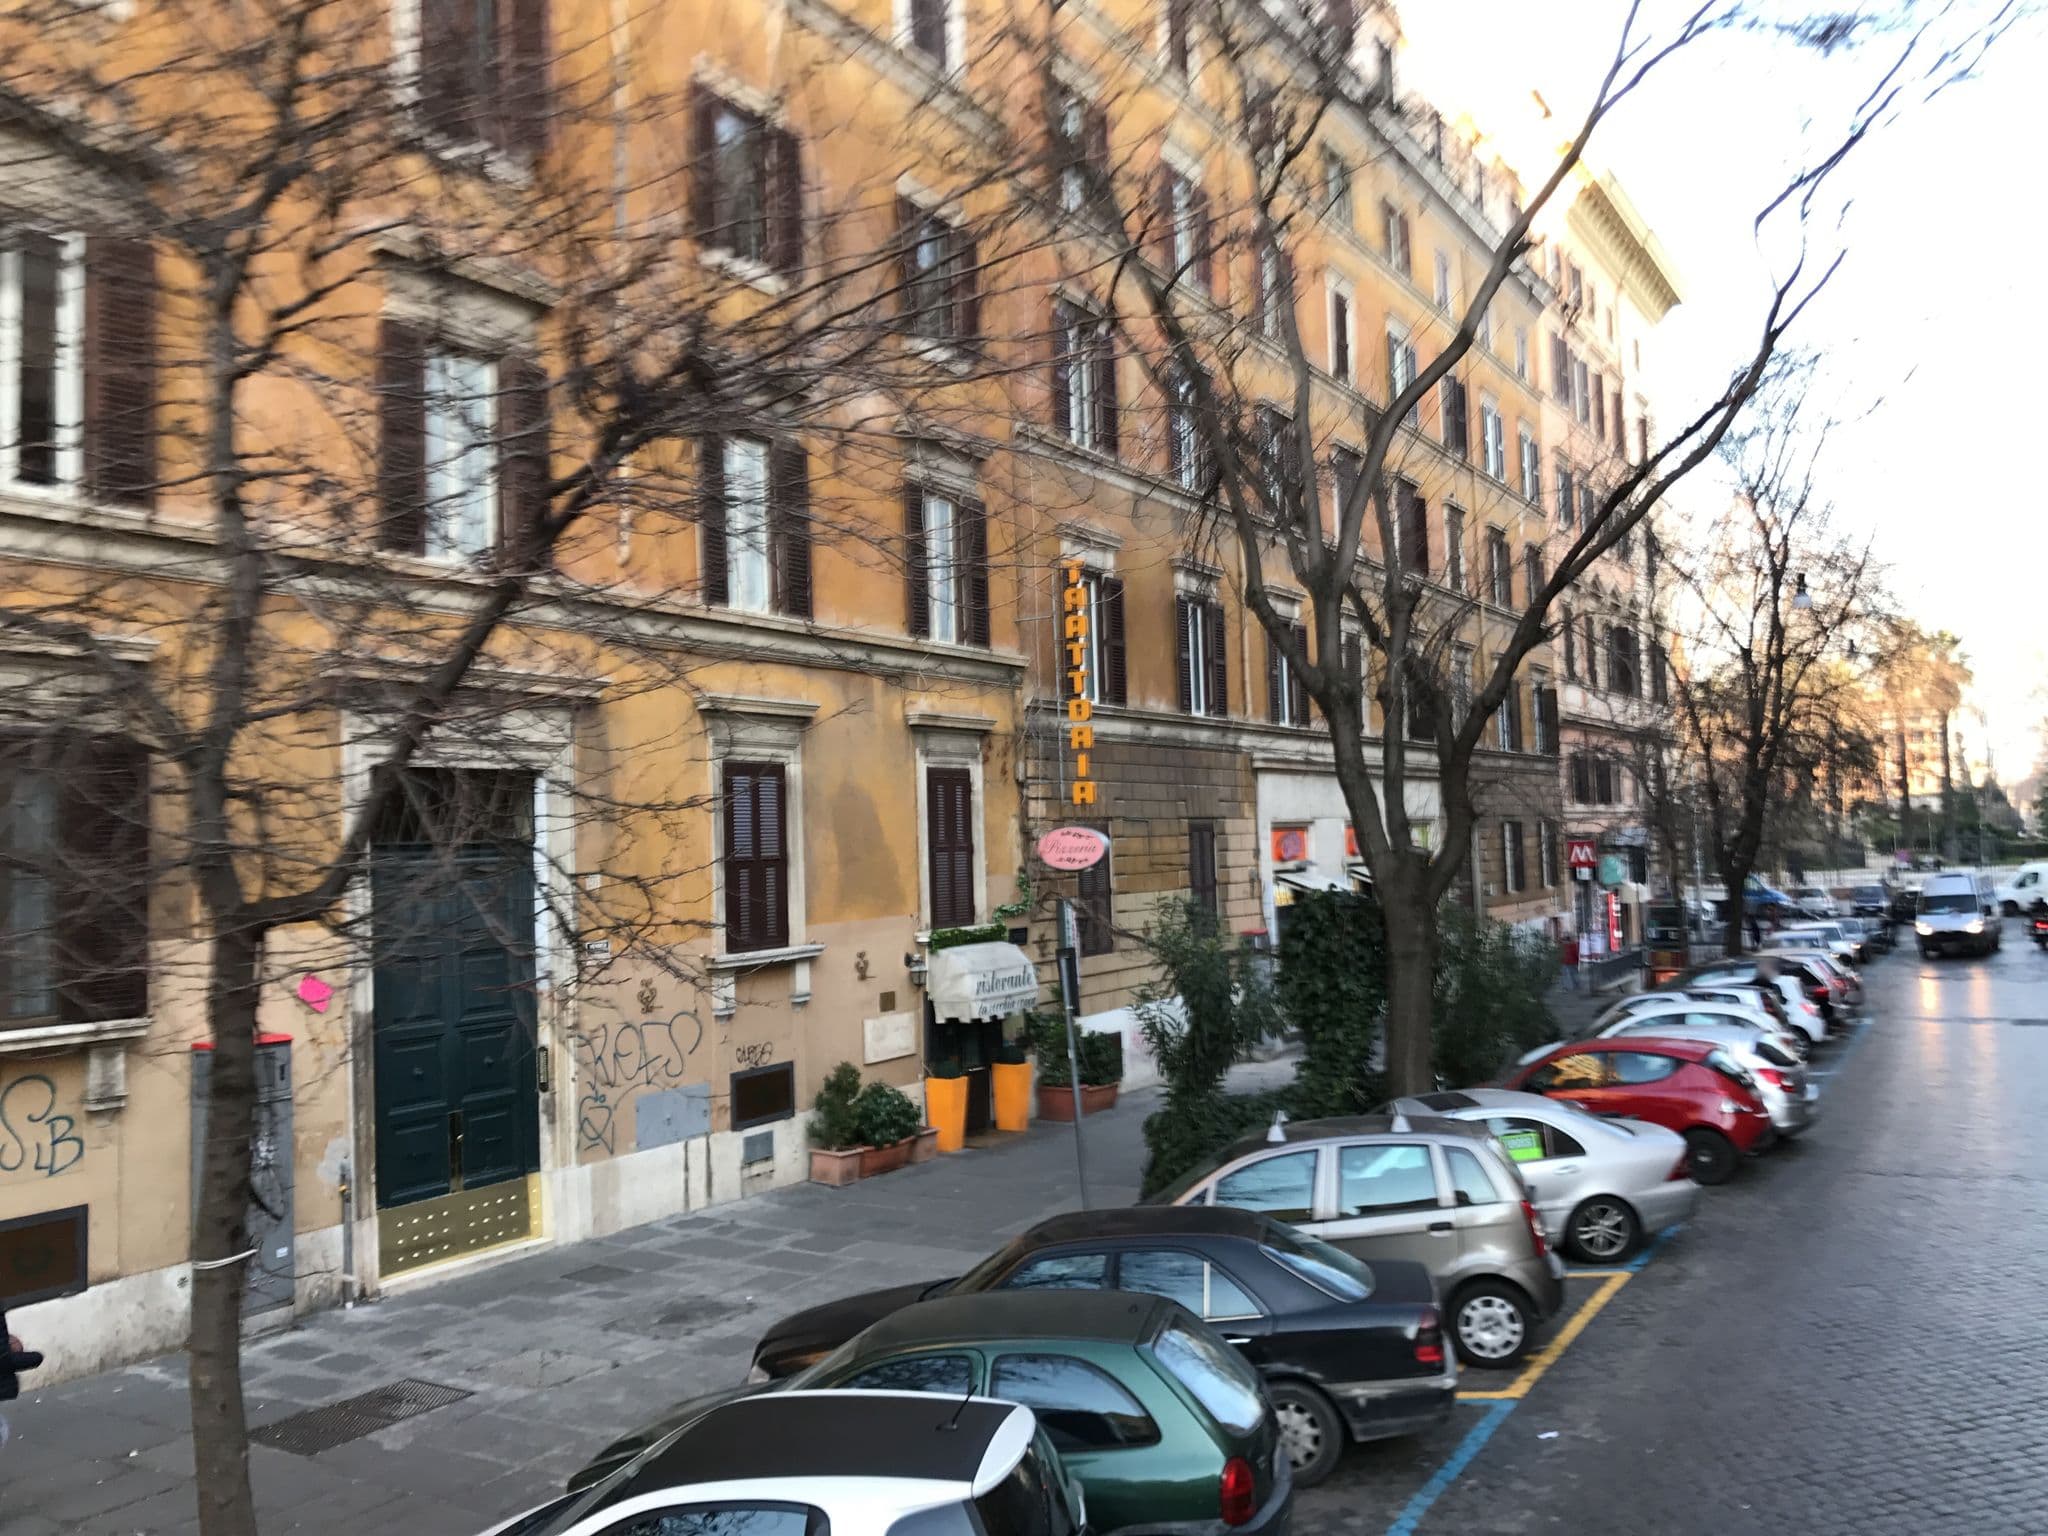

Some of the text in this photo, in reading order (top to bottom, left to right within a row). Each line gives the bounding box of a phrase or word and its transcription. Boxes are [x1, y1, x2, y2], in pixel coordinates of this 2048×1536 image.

[1061, 559, 1097, 805] TRATTORIA
[1570, 845, 1595, 863] M
[975, 965, 1033, 996] ristorante
